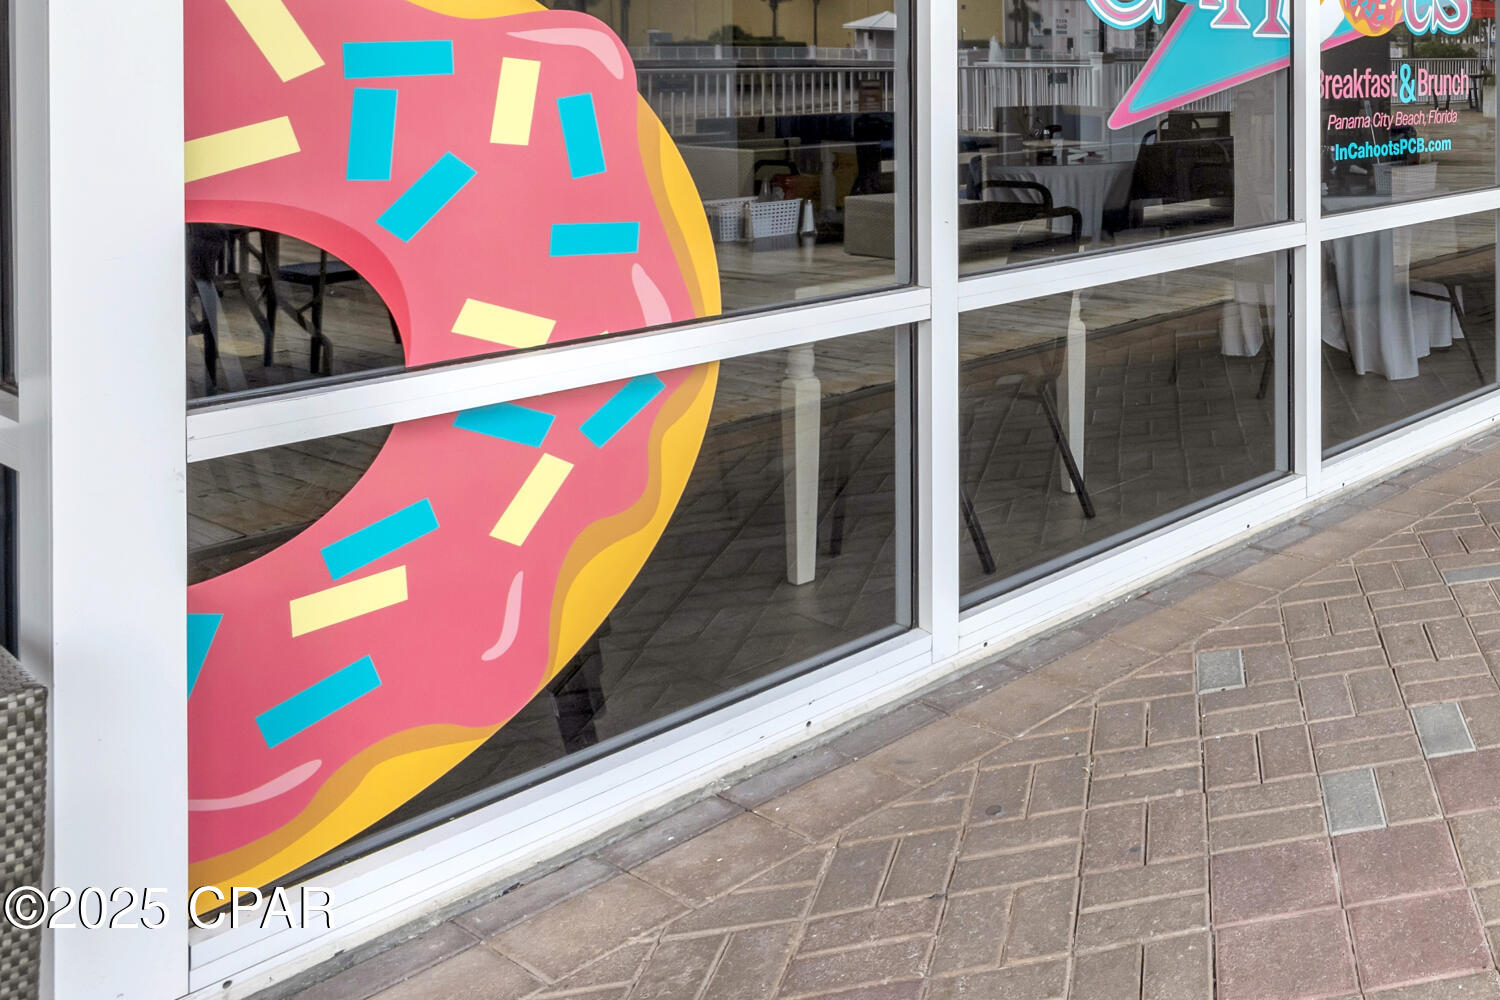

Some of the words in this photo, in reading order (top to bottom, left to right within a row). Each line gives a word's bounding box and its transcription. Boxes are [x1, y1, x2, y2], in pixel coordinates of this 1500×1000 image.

[1399, 63, 1416, 104] &
[1418, 68, 1469, 98] Brunch
[1328, 114, 1371, 130] Panama
[1372, 111, 1393, 130] City
[1395, 110, 1426, 127] Beach,
[1428, 108, 1458, 125] Florida
[1334, 137, 1452, 161] InCahootsPCB.com
